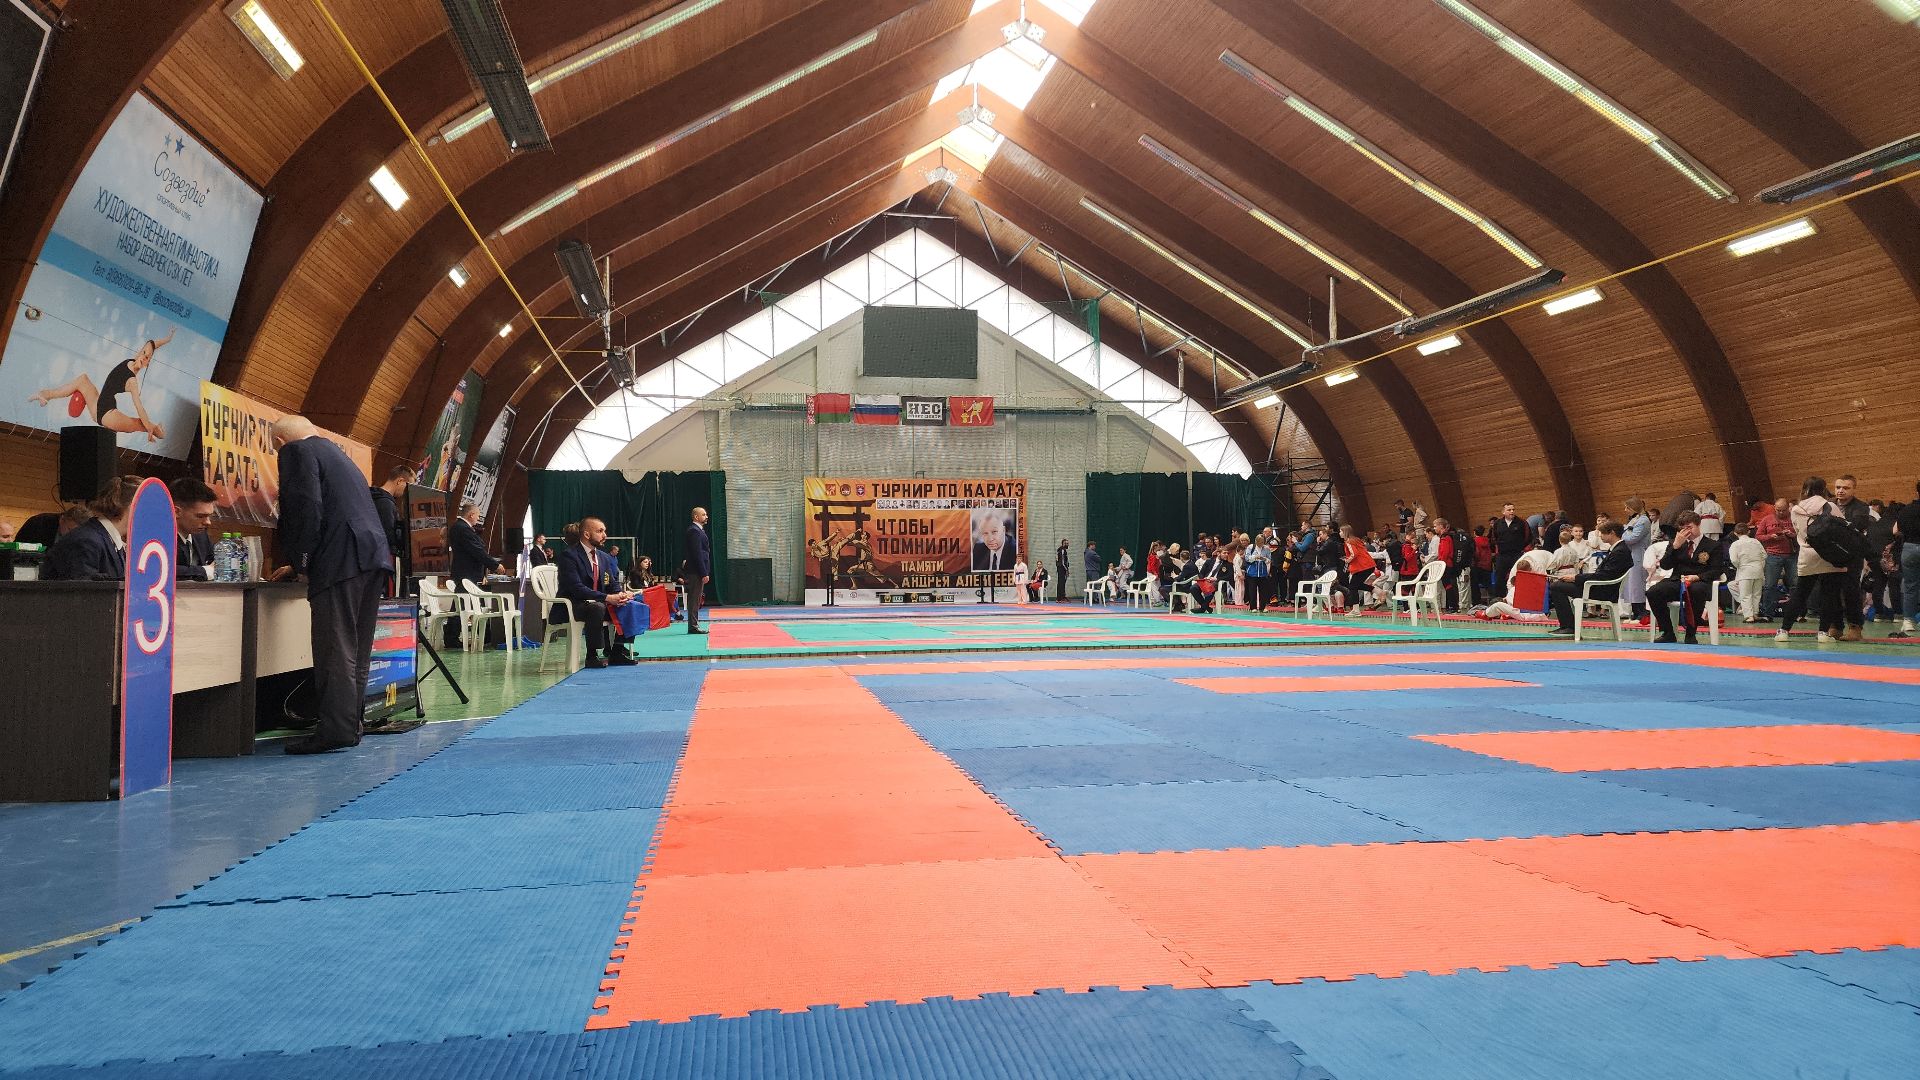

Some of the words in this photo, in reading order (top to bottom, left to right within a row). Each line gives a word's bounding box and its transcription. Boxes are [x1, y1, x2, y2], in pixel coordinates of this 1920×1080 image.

[154, 151, 206, 207] Созвездие
[94, 186, 176, 254] ХУДОЖЕСТВЕННАЯ
[176, 235, 219, 279] ГИМНАСТИКА
[117, 231, 140, 256] НАБОР
[138, 244, 169, 273] ДЕВОЧЕК
[204, 397, 257, 449] ТУРНИР
[203, 446, 260, 492] КАРАТЭ
[871, 483, 933, 497] ТУРНИР
[936, 483, 958, 497] ПО
[963, 483, 1025, 497] КАРАТЭ
[876, 518, 935, 535] ЧТОБЫ
[900, 560, 944, 572] ПАМЯТИ
[901, 574, 950, 588] АНДРЕЯ
[955, 572, 1015, 588] АЛЕКСЕЕВ
[135, 539, 169, 655] 3
